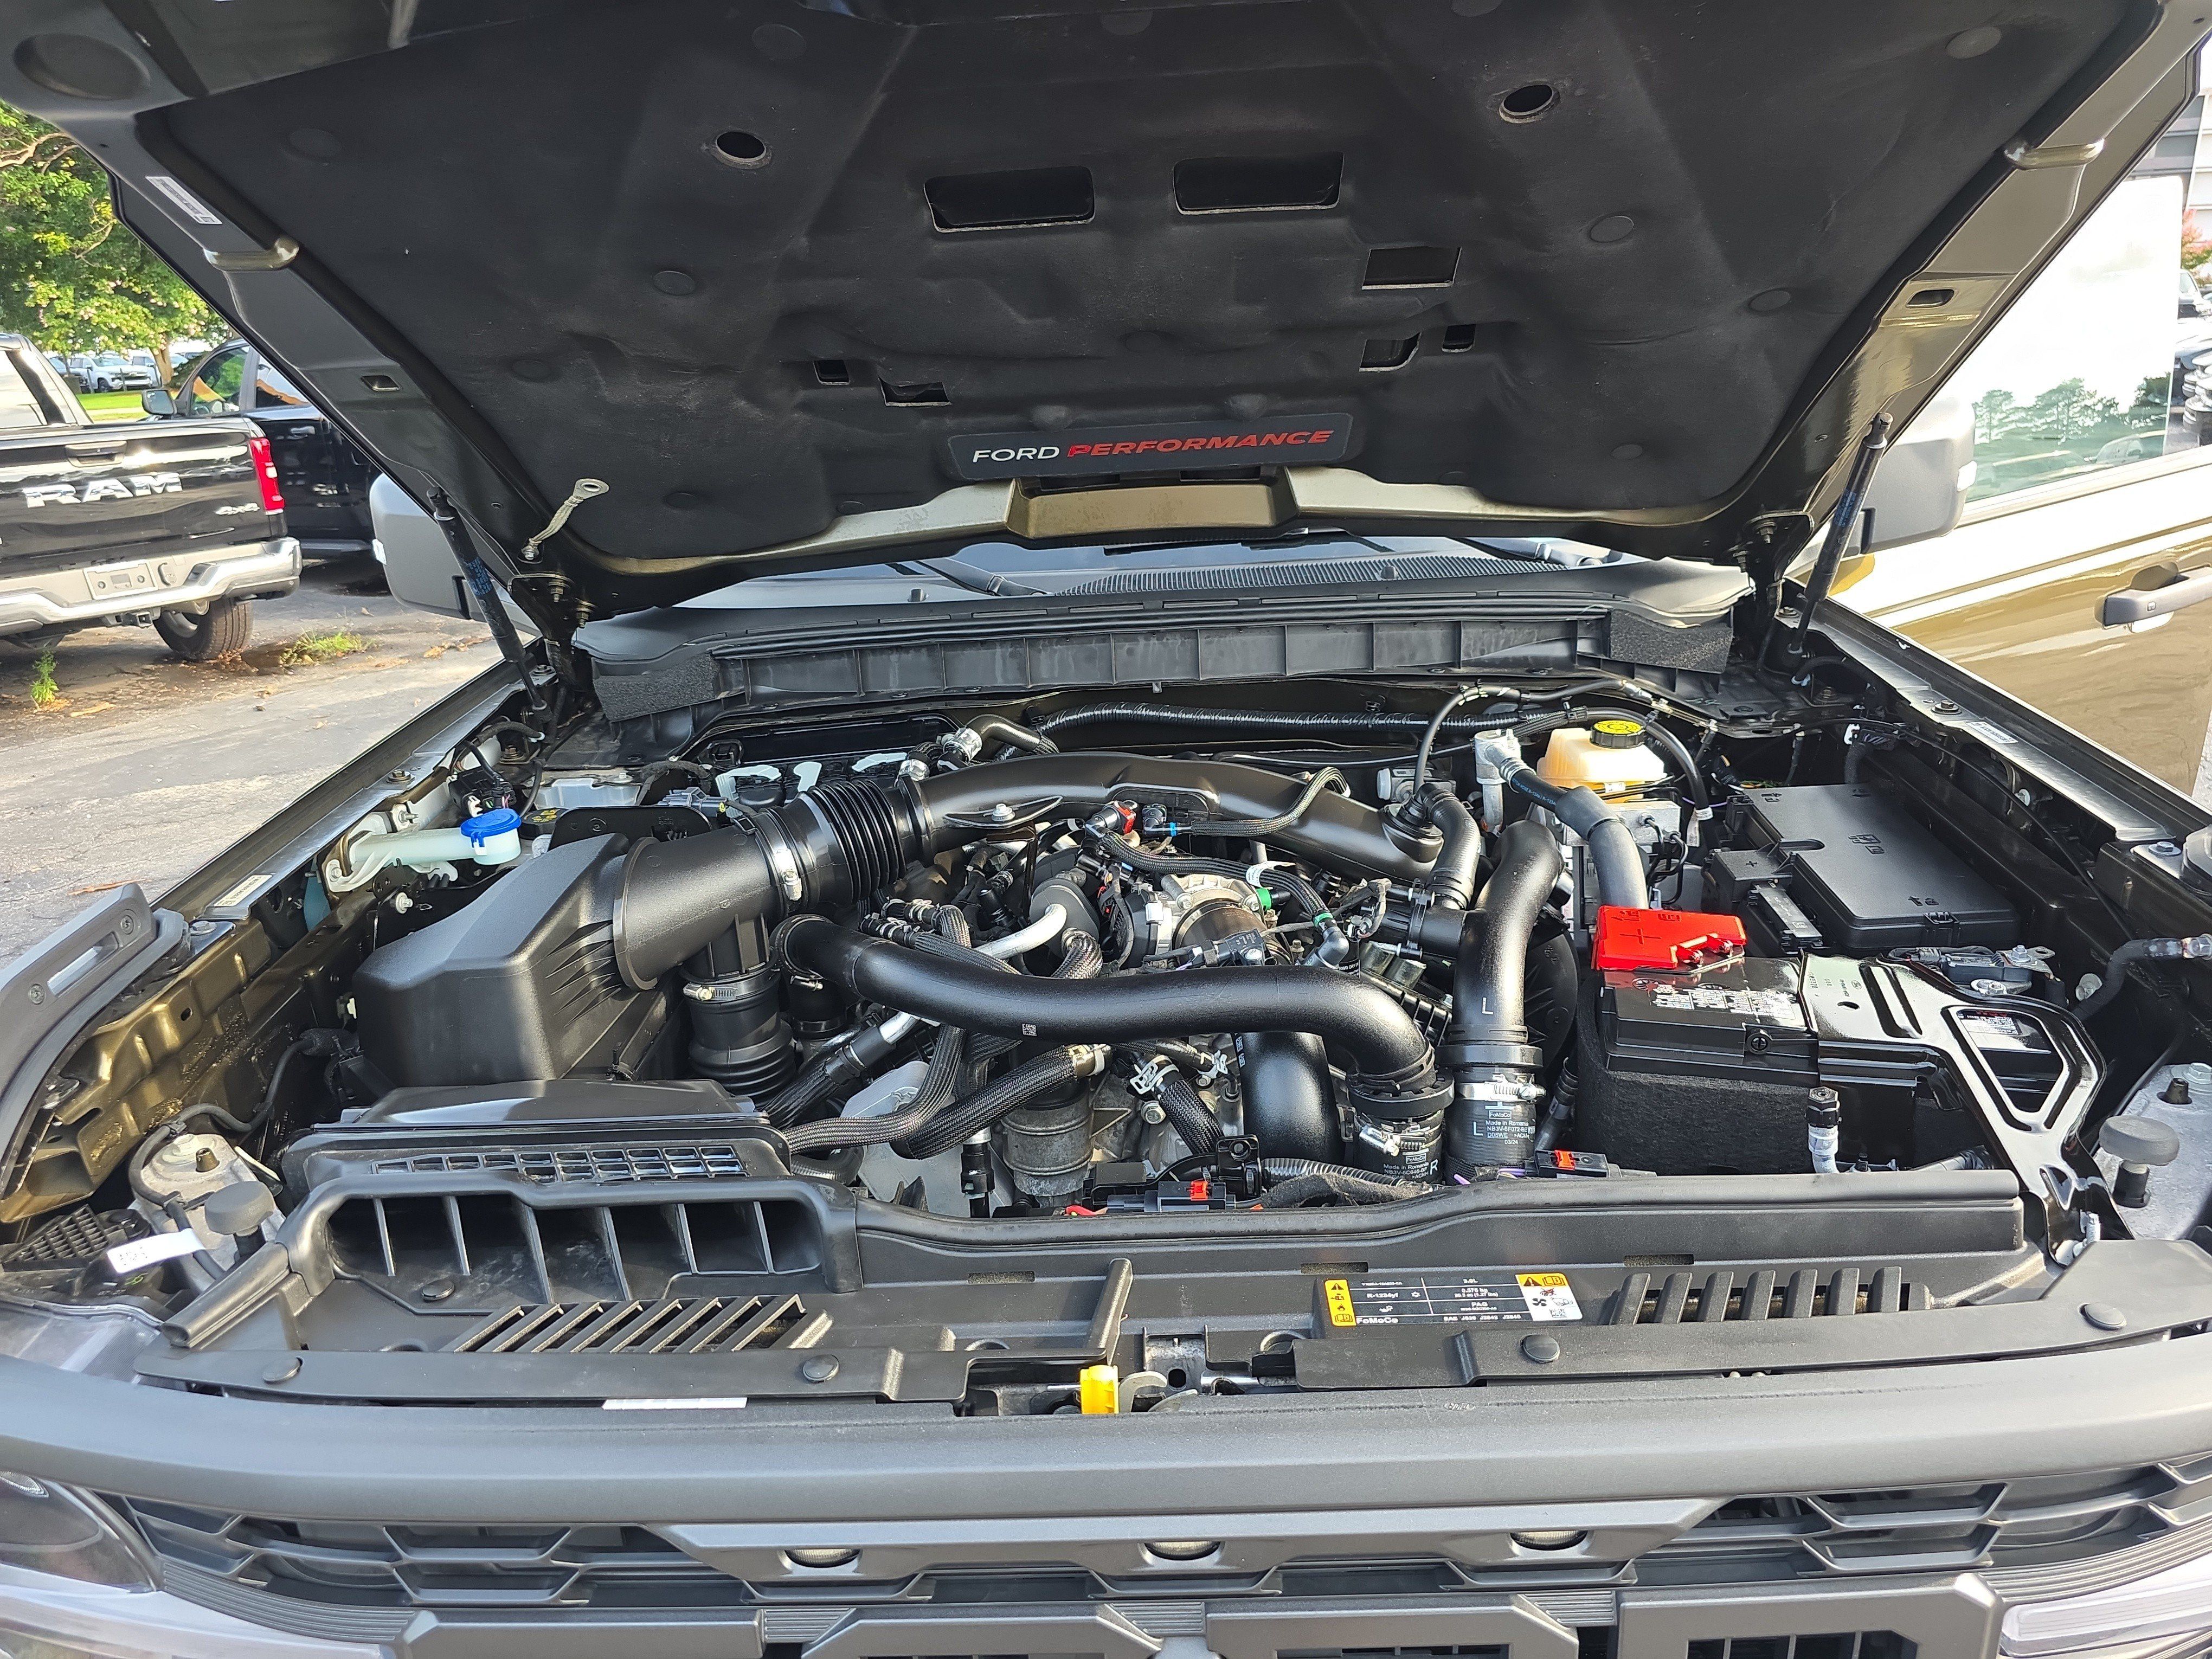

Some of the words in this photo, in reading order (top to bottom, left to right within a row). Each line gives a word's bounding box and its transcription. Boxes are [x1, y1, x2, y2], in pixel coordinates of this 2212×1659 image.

[972, 447, 1059, 463] FORD
[1067, 430, 1334, 457] PERFORMANCE
[23, 472, 183, 508] RAM
[215, 502, 261, 516] 4x4
[1481, 996, 1494, 1015] L
[1473, 1121, 1484, 1136] L
[1429, 1159, 1438, 1175] R
